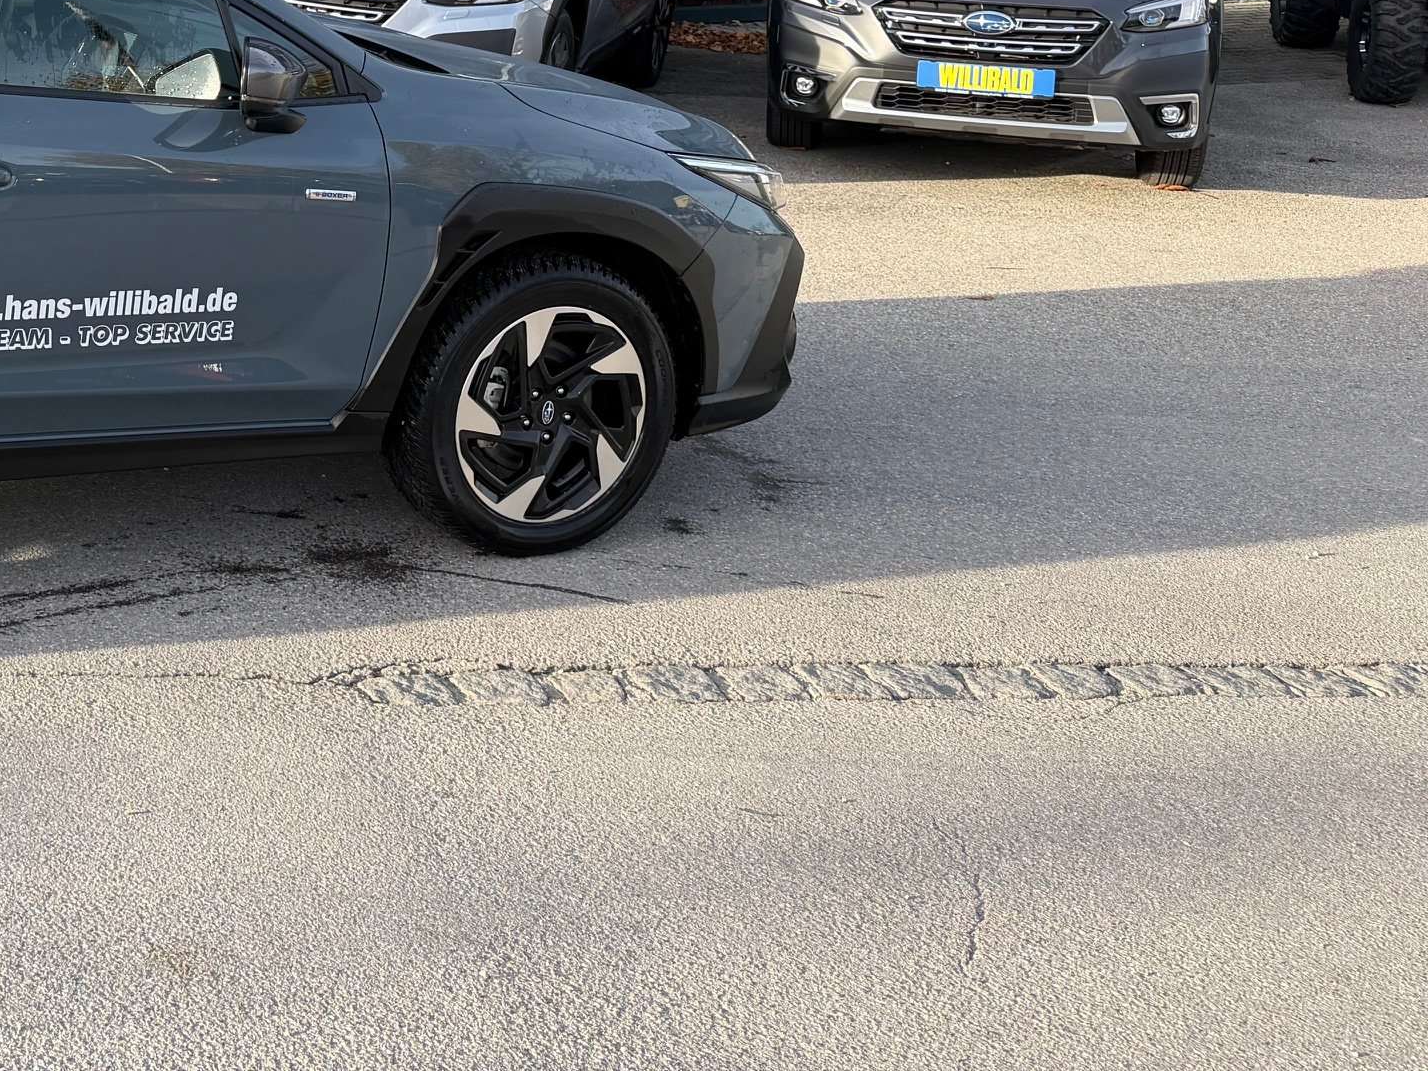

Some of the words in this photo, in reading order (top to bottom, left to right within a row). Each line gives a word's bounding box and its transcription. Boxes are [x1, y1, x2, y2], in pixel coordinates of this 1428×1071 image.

[938, 62, 1035, 94] WILLIBALD
[59, 334, 71, 345] -
[78, 324, 129, 347] TOP
[134, 320, 235, 345] SERVICE
